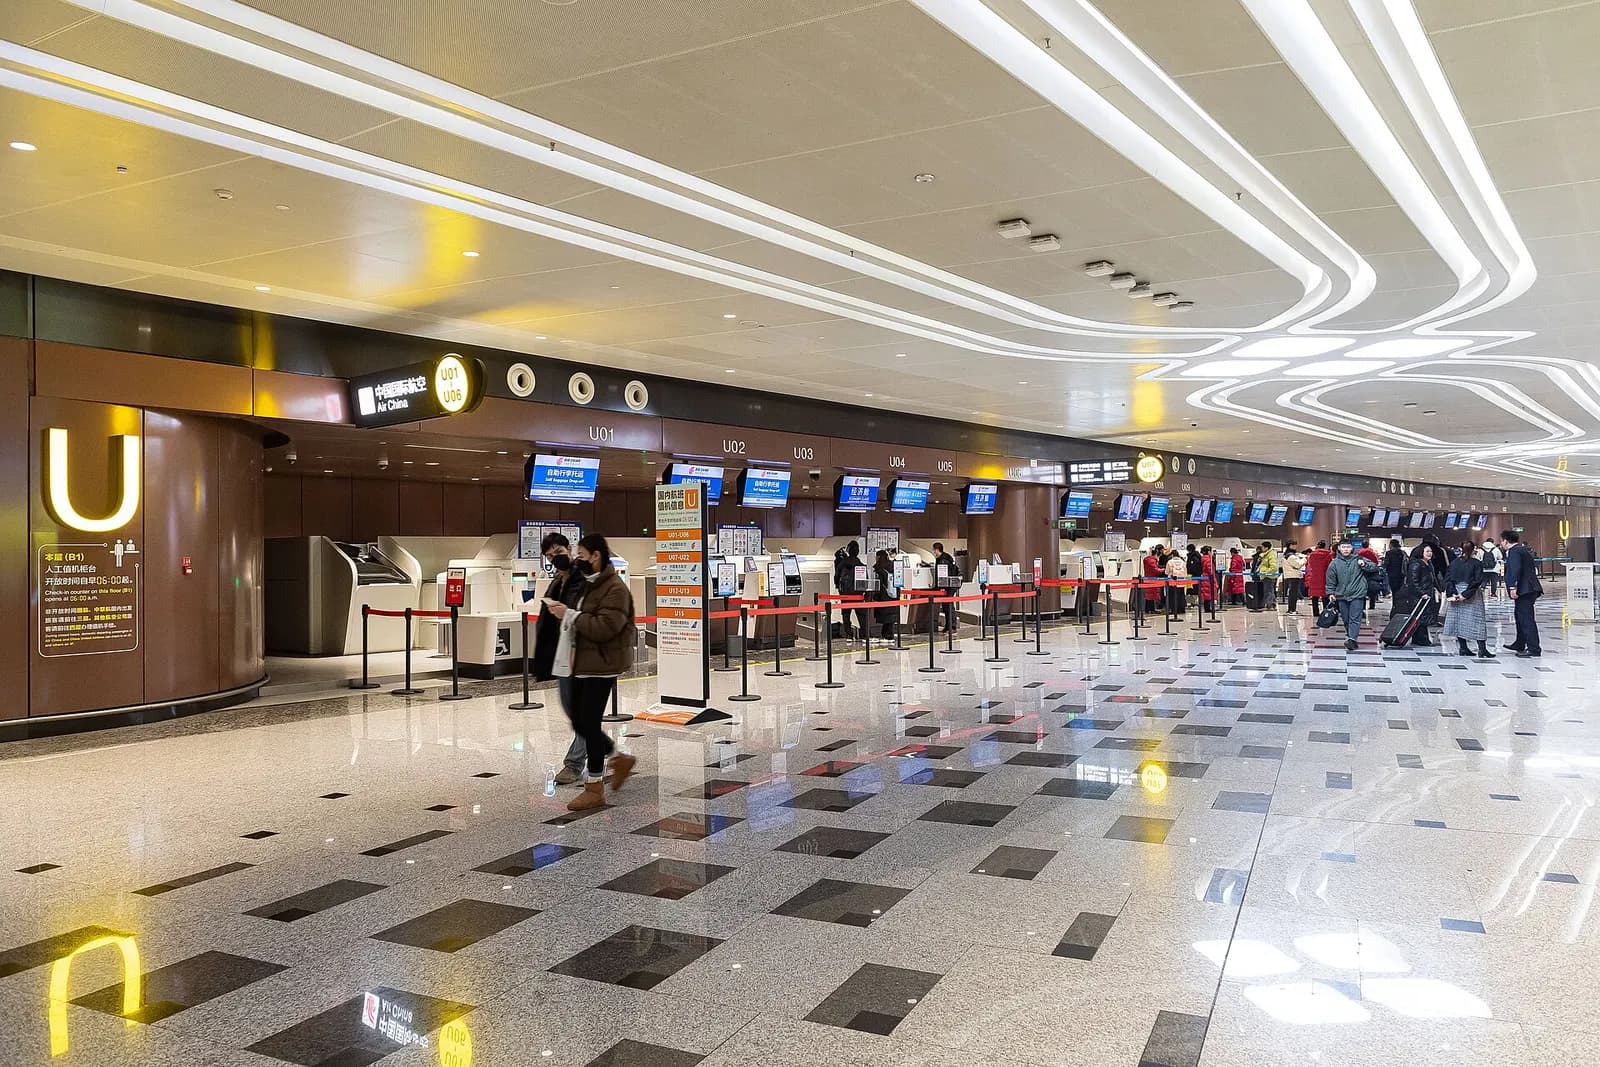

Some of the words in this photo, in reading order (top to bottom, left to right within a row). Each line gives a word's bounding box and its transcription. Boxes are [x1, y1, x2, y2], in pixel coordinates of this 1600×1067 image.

[441, 367, 459, 381] U01
[443, 389, 462, 403] U06
[377, 401, 388, 413] Air
[388, 398, 409, 411] China
[589, 426, 615, 442] U01
[723, 439, 746, 454] U02
[793, 447, 814, 461] U03
[889, 456, 906, 468] U04
[937, 460, 953, 473] U05
[42, 427, 140, 532] U
[658, 489, 684, 500] 国内航班
[687, 493, 696, 507] U
[658, 500, 684, 511] 值机信息
[65, 552, 85, 562] (B1)
[45, 565, 97, 574] 人工值机柜台
